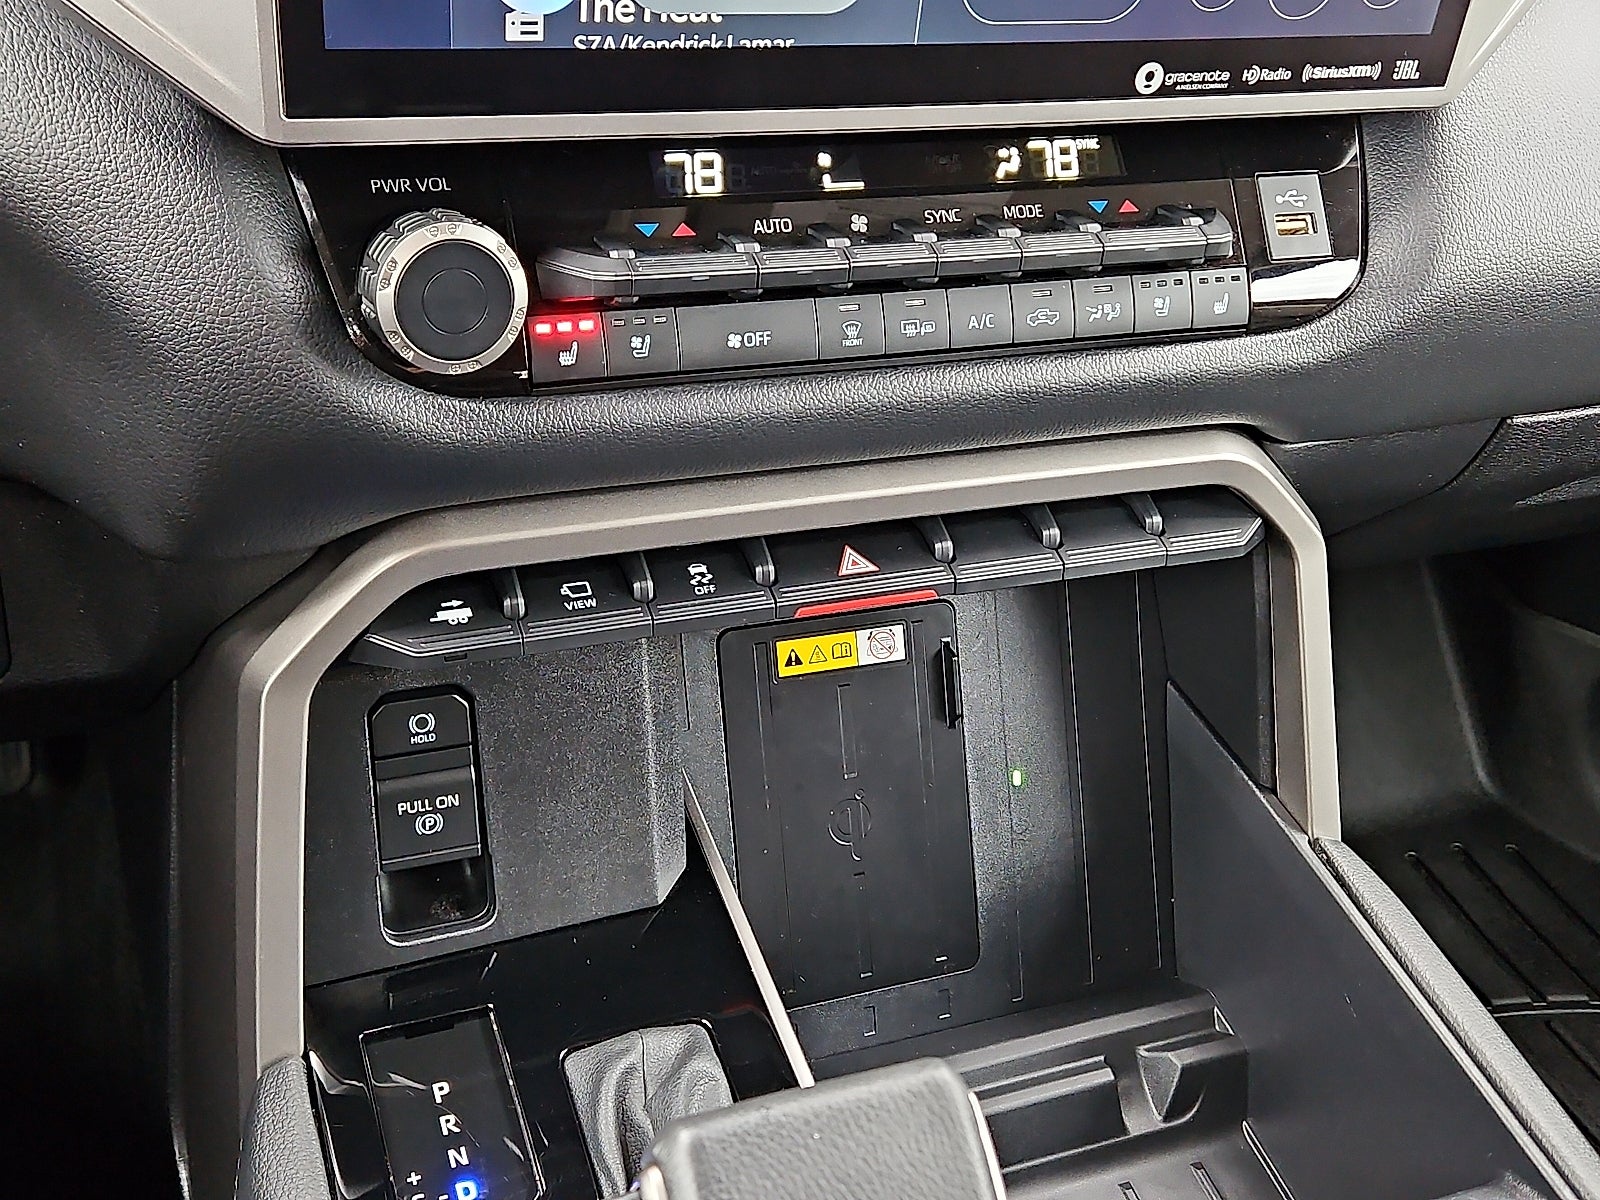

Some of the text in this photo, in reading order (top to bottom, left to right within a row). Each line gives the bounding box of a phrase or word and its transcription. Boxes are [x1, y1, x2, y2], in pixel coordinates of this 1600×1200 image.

[1164, 69, 1231, 86] gracenote
[1260, 67, 1292, 81] Radio
[1392, 59, 1420, 80] JBL
[1026, 139, 1080, 179] 78
[663, 151, 724, 195] 78
[370, 177, 451, 194] PWR VOL
[924, 208, 962, 224] SYNC
[1002, 204, 1044, 220] MODE
[753, 217, 793, 235] AUTO
[968, 313, 995, 330] A/C
[743, 330, 772, 348] OFF
[842, 337, 863, 347] FRONT
[694, 584, 717, 596] OFF
[564, 597, 597, 612] VIEW
[410, 733, 437, 744] HOLD
[397, 793, 460, 816] PULL ON
[425, 817, 435, 831] P
[432, 1081, 450, 1104] P
[439, 1114, 461, 1136] R
[447, 1145, 470, 1169] N
[454, 1180, 479, 1200] D
